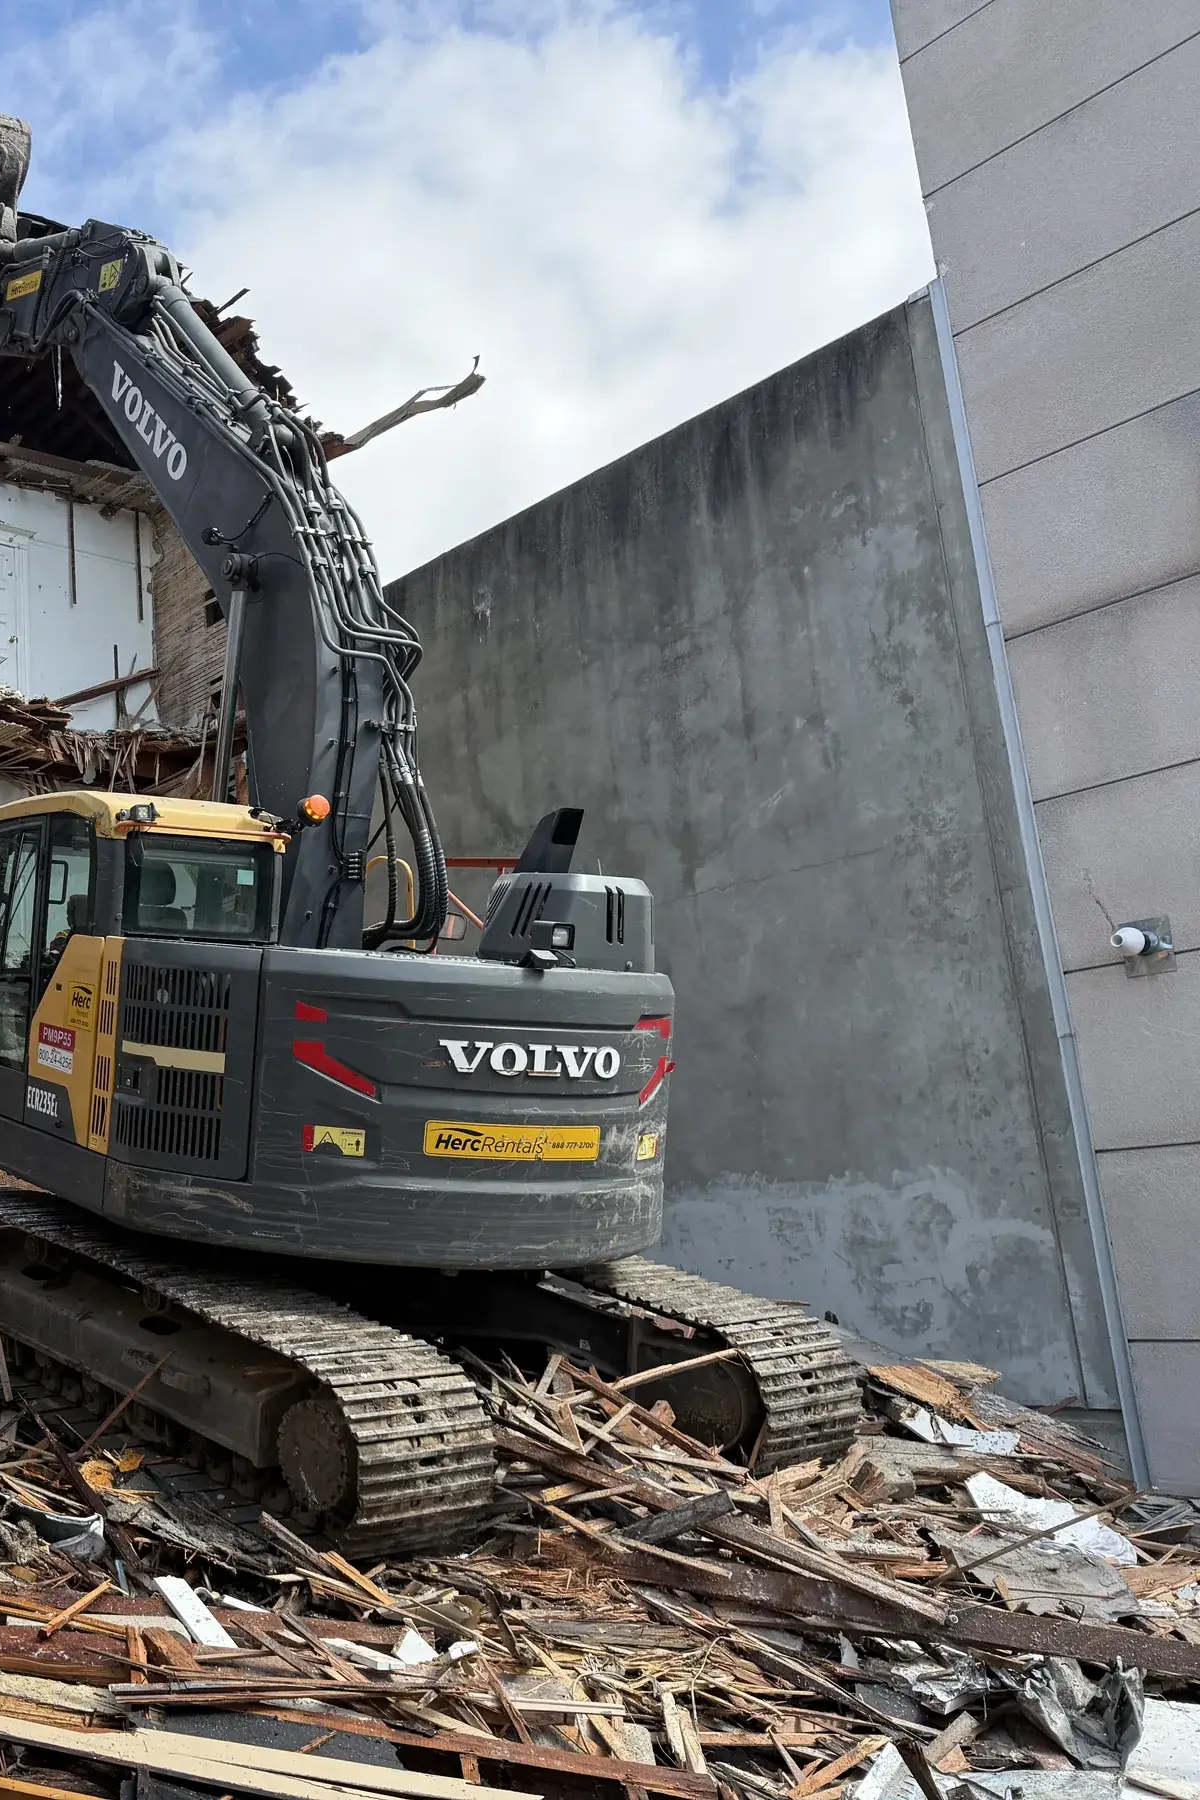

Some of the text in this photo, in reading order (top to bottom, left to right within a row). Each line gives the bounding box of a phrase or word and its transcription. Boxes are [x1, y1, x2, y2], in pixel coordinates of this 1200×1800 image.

[111, 360, 187, 480] VOLVO
[71, 991, 92, 1010] Herc
[42, 1026, 72, 1047] PM9P55
[438, 1039, 621, 1079] VOLVO
